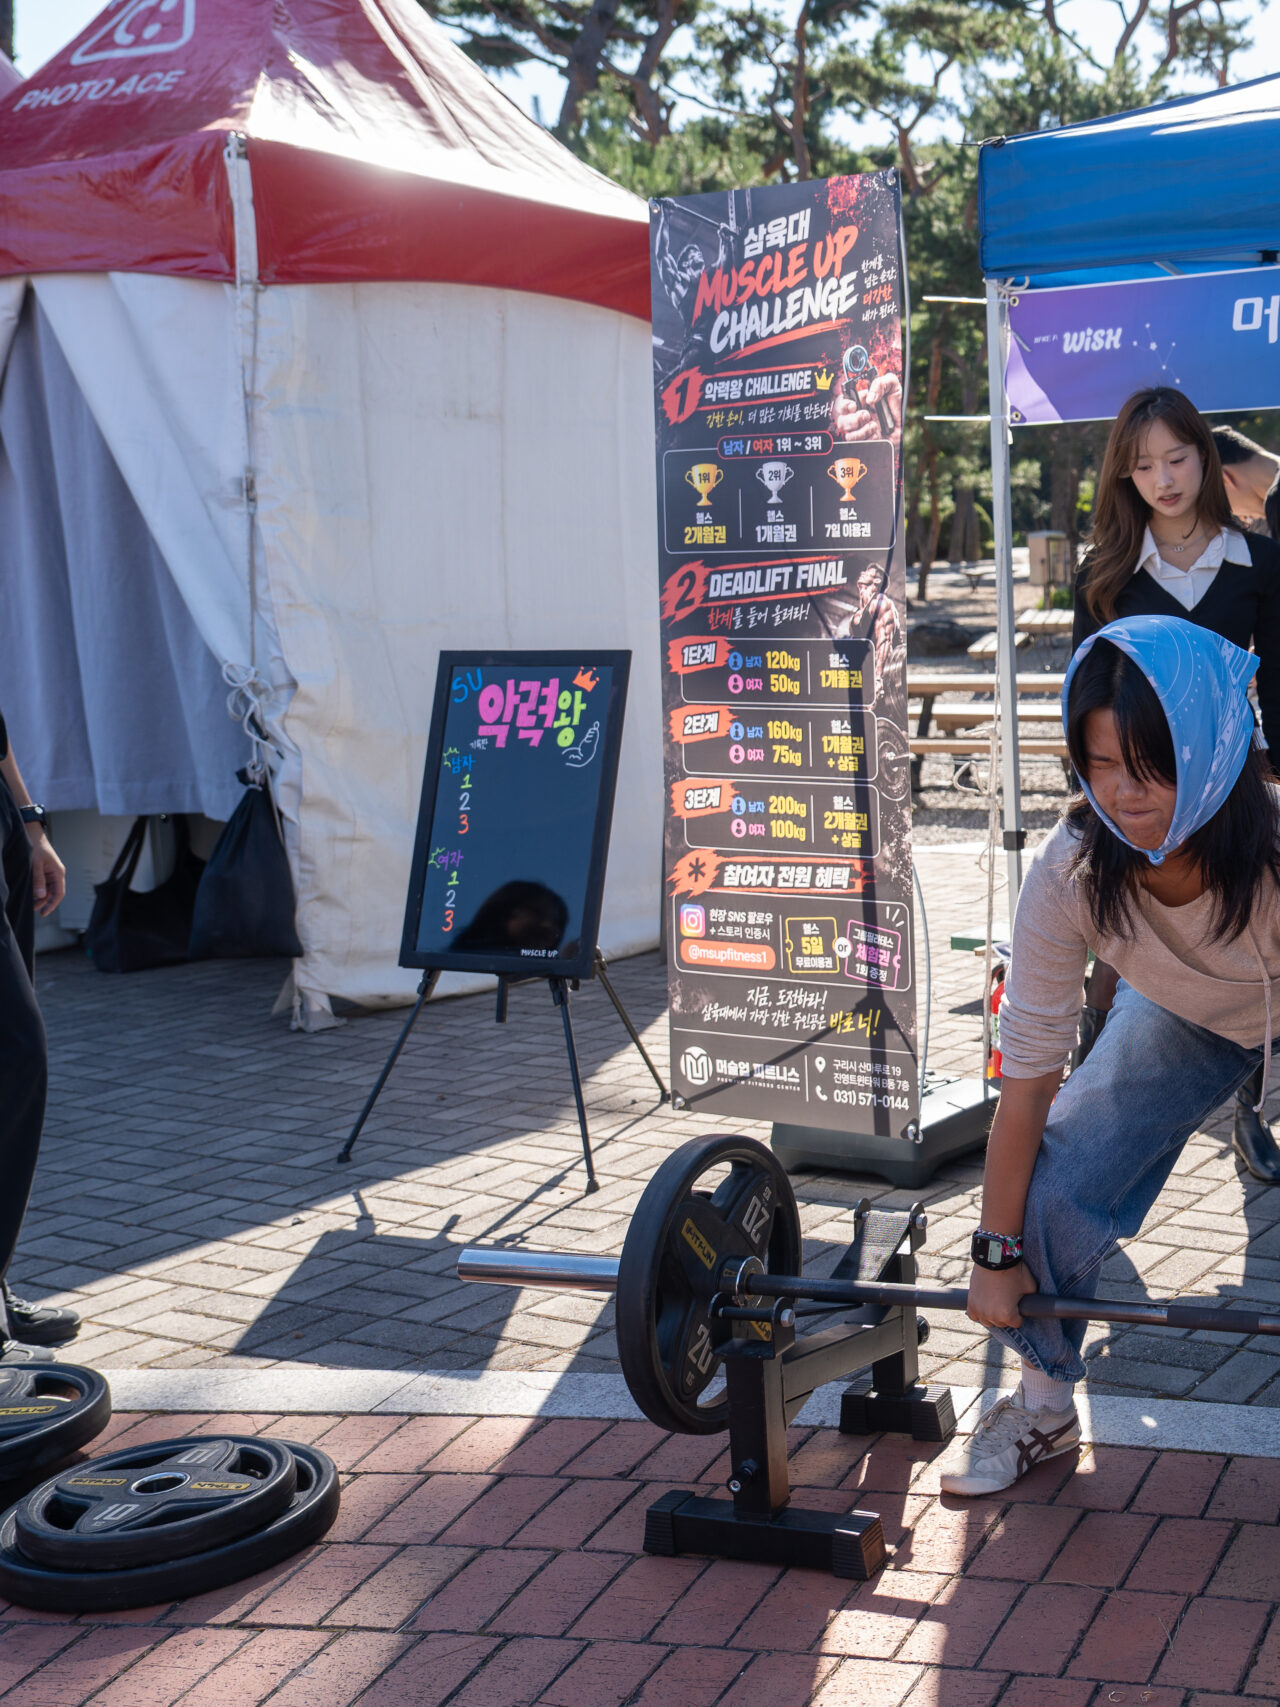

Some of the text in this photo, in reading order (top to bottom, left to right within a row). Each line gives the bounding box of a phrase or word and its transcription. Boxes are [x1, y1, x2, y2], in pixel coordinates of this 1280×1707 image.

[12, 70, 187, 112] PHOTO ACE
[744, 208, 812, 258] 삼육대
[691, 225, 859, 327] MUSCLE UP
[710, 270, 859, 353] CHALLENGE
[676, 370, 812, 417] 1 악력왕 CHALLENGE
[706, 401, 834, 428] 강한 손이, 더 많은 기회를 만든다!
[768, 469, 781, 482] 2위
[840, 467, 854, 478] 3위
[684, 526, 727, 544] 2개월권
[756, 524, 797, 542] 1개월권
[825, 523, 871, 538] 7일 이용권
[674, 560, 848, 608] 2 DEADLIFT FINAL
[708, 603, 811, 630] 한계를 들어 올려라!
[682, 643, 715, 665] 1단계
[746, 651, 800, 671] 남자 120kg
[829, 654, 850, 666] 헬스
[452, 668, 483, 702] SU
[746, 674, 800, 695] 여자 50kg
[820, 671, 863, 688] 1개월권
[478, 678, 587, 748] 악력왕
[684, 713, 718, 735] 2단계
[747, 721, 803, 742] 남자 160kg
[822, 736, 864, 754] 1개월권
[451, 755, 476, 774] 남자
[747, 745, 802, 766] 여자 75kg
[461, 774, 472, 788] 1
[459, 792, 471, 811] 2
[684, 787, 720, 809] 3단계
[748, 796, 807, 817] 남자 200kg
[458, 814, 469, 834] 3
[749, 820, 806, 841] 여자 100kg
[824, 812, 868, 831] 2개월권
[437, 850, 465, 871] 여자
[448, 871, 459, 885] 1
[723, 865, 850, 889] 참여자 전원 혜택
[445, 889, 455, 907] 2
[442, 910, 454, 932] 3
[709, 909, 773, 926] 현장 SNS 팔로우
[520, 948, 558, 959] MUSCLE UP
[688, 944, 767, 964] @msupfitness1
[801, 937, 824, 955] 5일
[796, 957, 832, 969] 무료이용권
[747, 986, 828, 1010] 지금, 도전하라!
[701, 1002, 880, 1038] 삼육대에서 가장 강한 주인공은 바로 너!
[716, 1059, 800, 1082] 머슬업 피트니스
[833, 1059, 901, 1075] 구리시 산마루로 19
[833, 1090, 909, 1110] 031) 571-0144
[742, 1196, 770, 1244] 20
[177, 1449, 219, 1464] 10
[93, 1504, 140, 1520] 10
